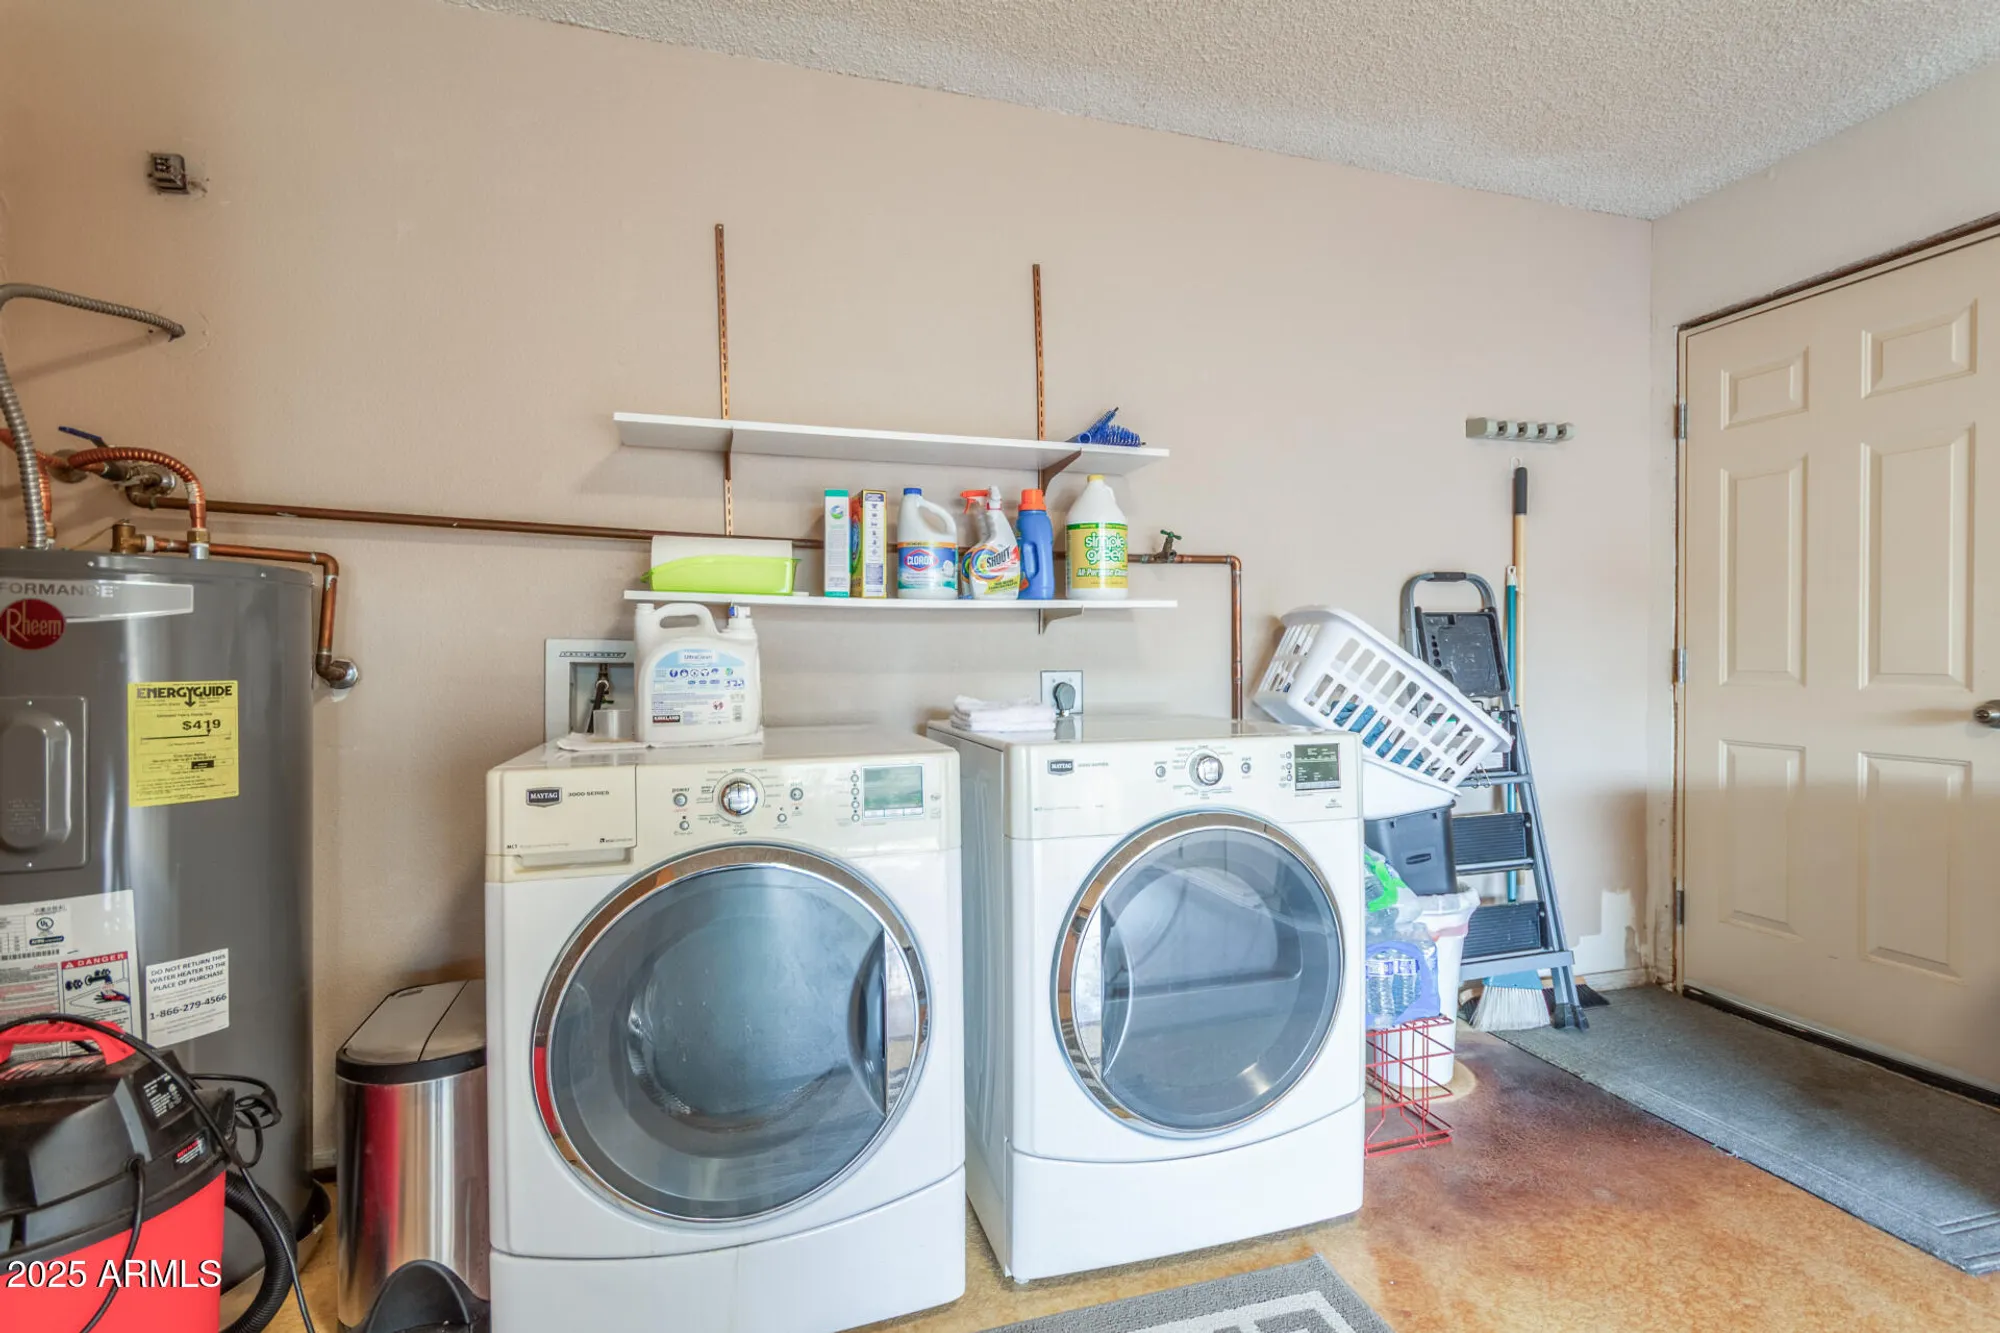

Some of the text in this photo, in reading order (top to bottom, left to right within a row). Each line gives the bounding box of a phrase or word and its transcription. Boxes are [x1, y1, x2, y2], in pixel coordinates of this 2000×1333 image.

[1084, 532, 1126, 551] simple
[907, 555, 934, 566] CLOROX
[986, 545, 1010, 568] SHOUT
[1085, 549, 1125, 565] green
[6, 600, 61, 642] Rheem
[136, 685, 233, 700] ENERGYGUIDE
[182, 719, 221, 731] $419
[530, 791, 558, 800] MAYTAG
[77, 954, 125, 967] DANGER
[165, 965, 181, 974] NOT
[183, 958, 211, 969] RETURN
[149, 974, 176, 984] WATER
[177, 968, 204, 978] HEATER
[153, 982, 176, 992] PLACE
[189, 970, 224, 983] PURCHASE
[150, 993, 227, 1020] 1-866-279-4566
